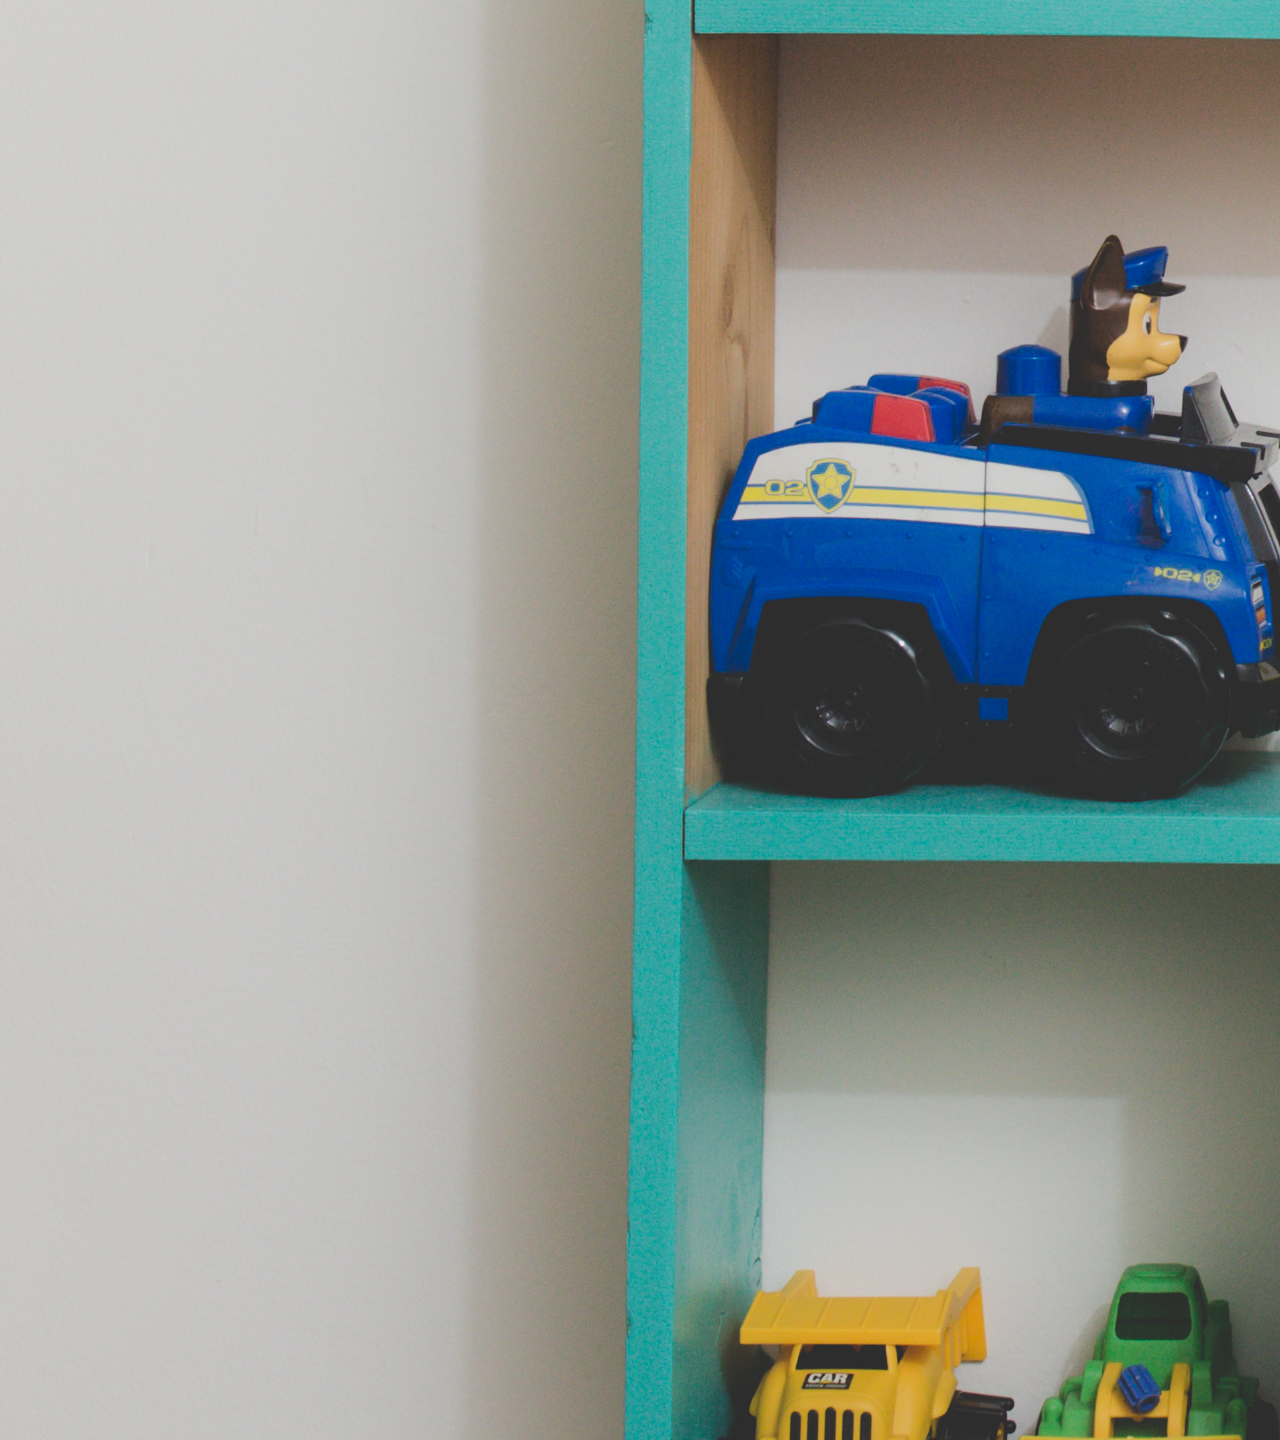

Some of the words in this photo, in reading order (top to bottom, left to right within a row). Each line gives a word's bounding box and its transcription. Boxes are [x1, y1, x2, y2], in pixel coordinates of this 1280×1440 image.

[765, 479, 804, 496] 02
[1162, 567, 1193, 582] 02
[807, 1373, 848, 1384] CAR
